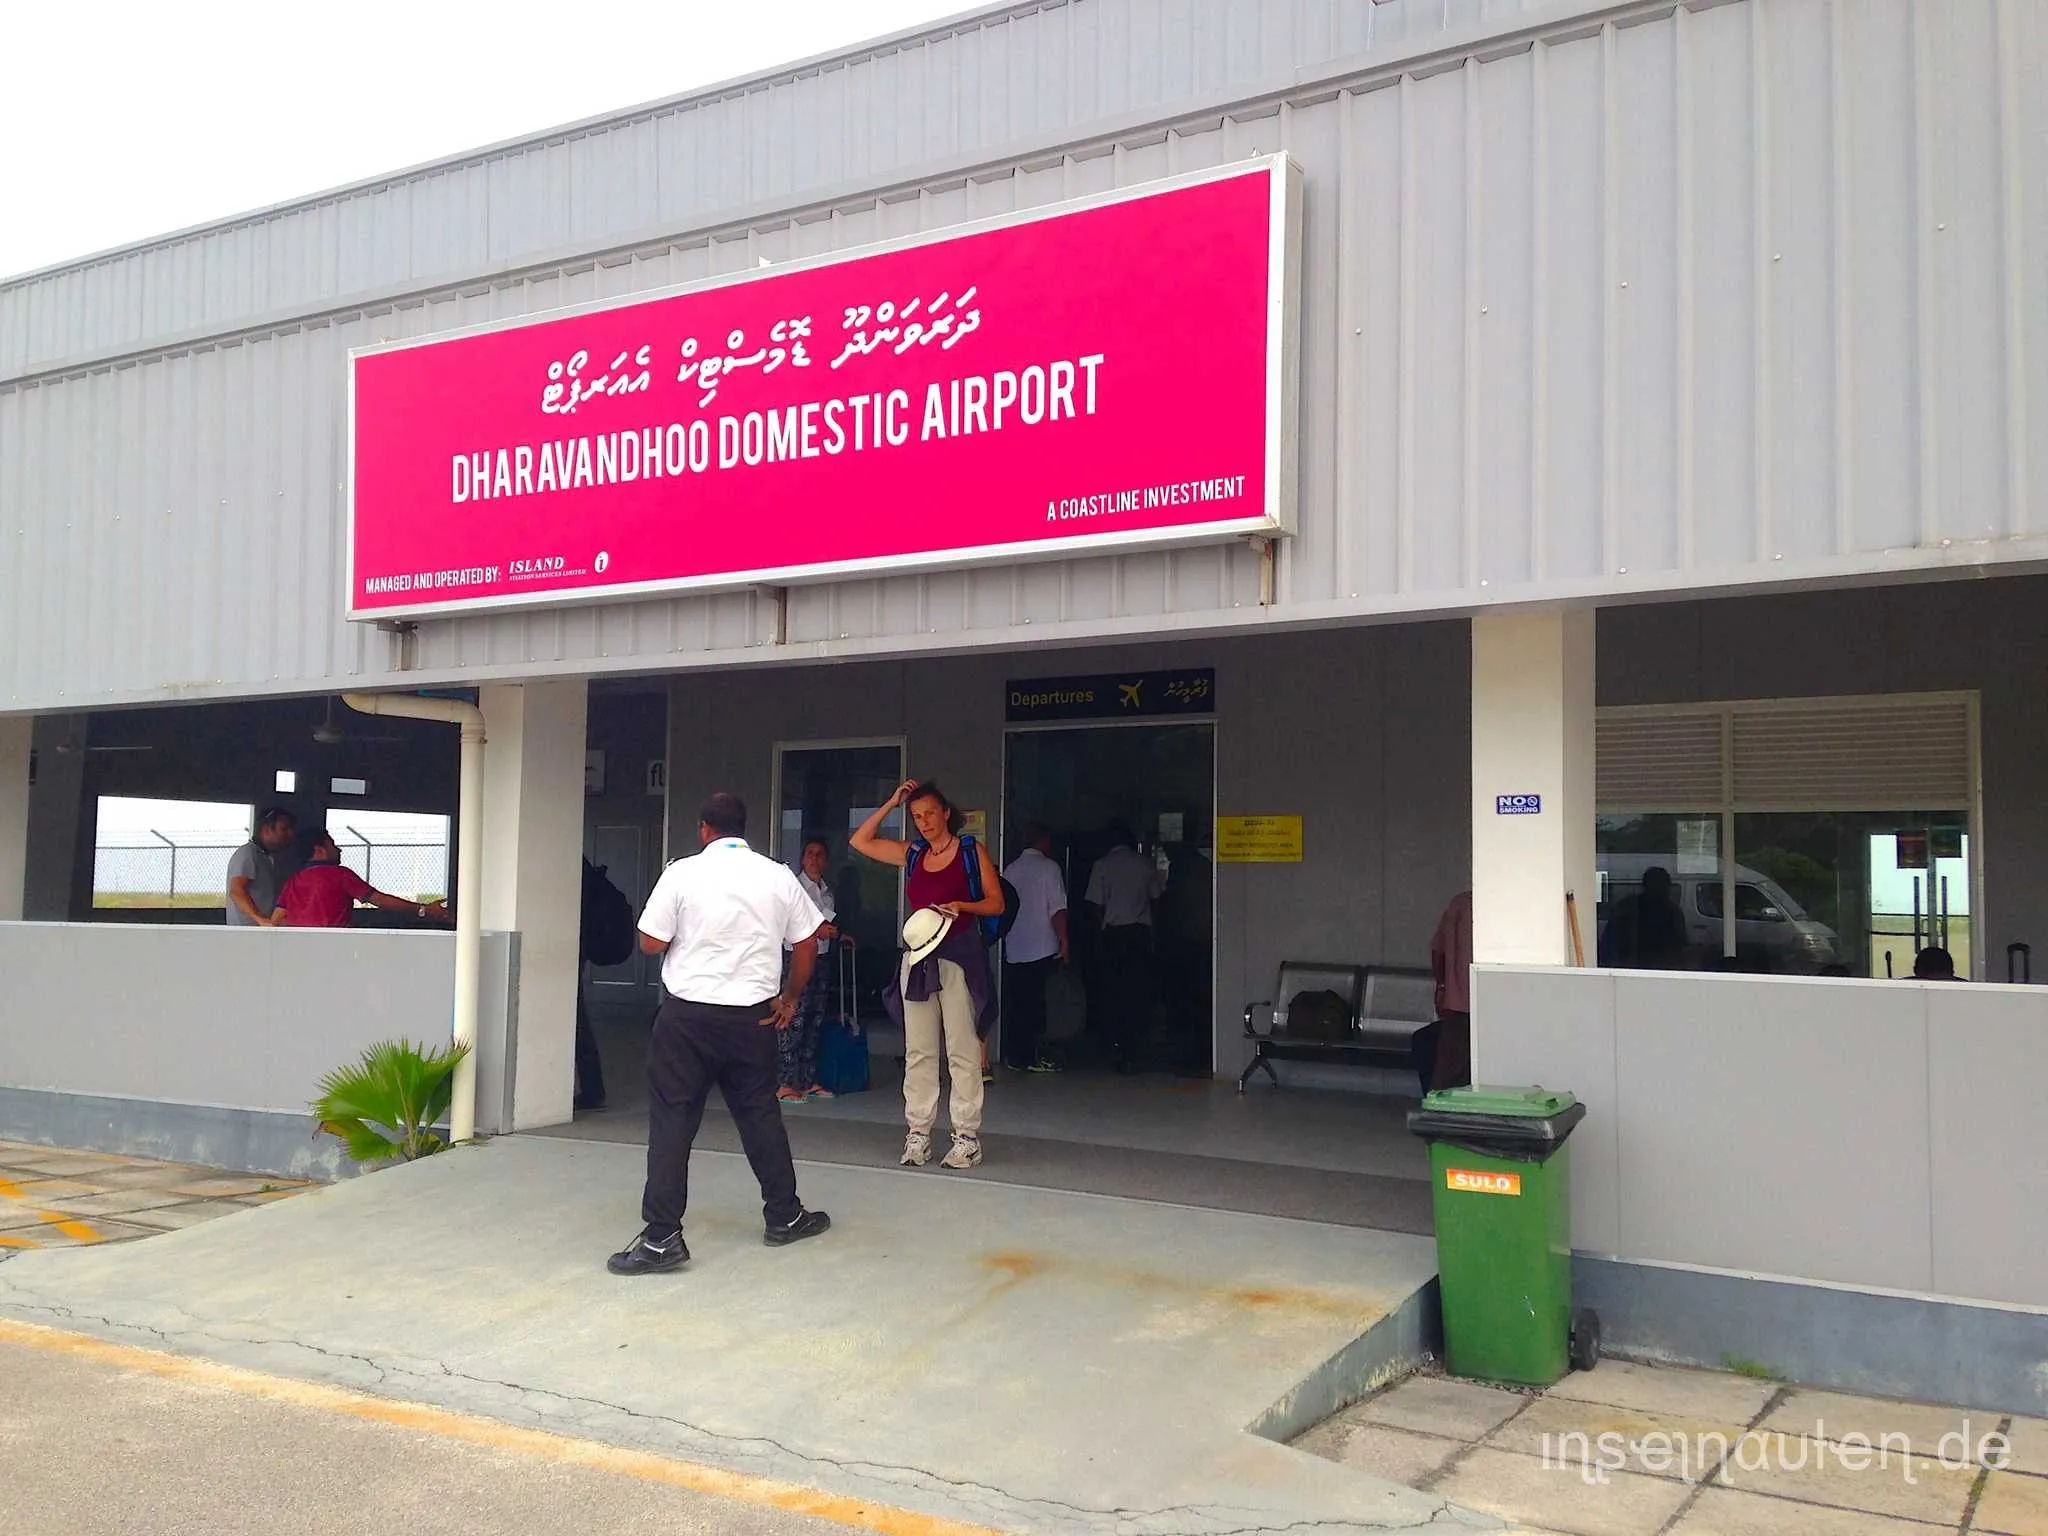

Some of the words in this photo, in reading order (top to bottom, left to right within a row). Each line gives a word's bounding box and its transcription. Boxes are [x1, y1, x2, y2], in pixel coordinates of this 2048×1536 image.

[830, 286, 981, 369] ދަރަވަންދޫ
[677, 315, 812, 409] ޑޮމެސްޓިކް
[452, 420, 709, 502] DHARAVANDHOO
[719, 388, 908, 468] DOMESTIC
[920, 353, 1105, 440] AIRPORT
[1047, 501, 1057, 520] A
[1060, 489, 1140, 519] COASTLINE
[1143, 475, 1245, 508] INVESTMENT
[509, 556, 565, 573] ISLAND
[561, 568, 587, 577] LIMITED
[365, 574, 411, 594] MANAGED
[413, 572, 432, 589] AND
[434, 567, 483, 588] OPERATED
[485, 565, 501, 584] BY:
[1011, 690, 1094, 708] Departures
[1499, 796, 1527, 806] NO
[1499, 806, 1539, 814] SMOKING
